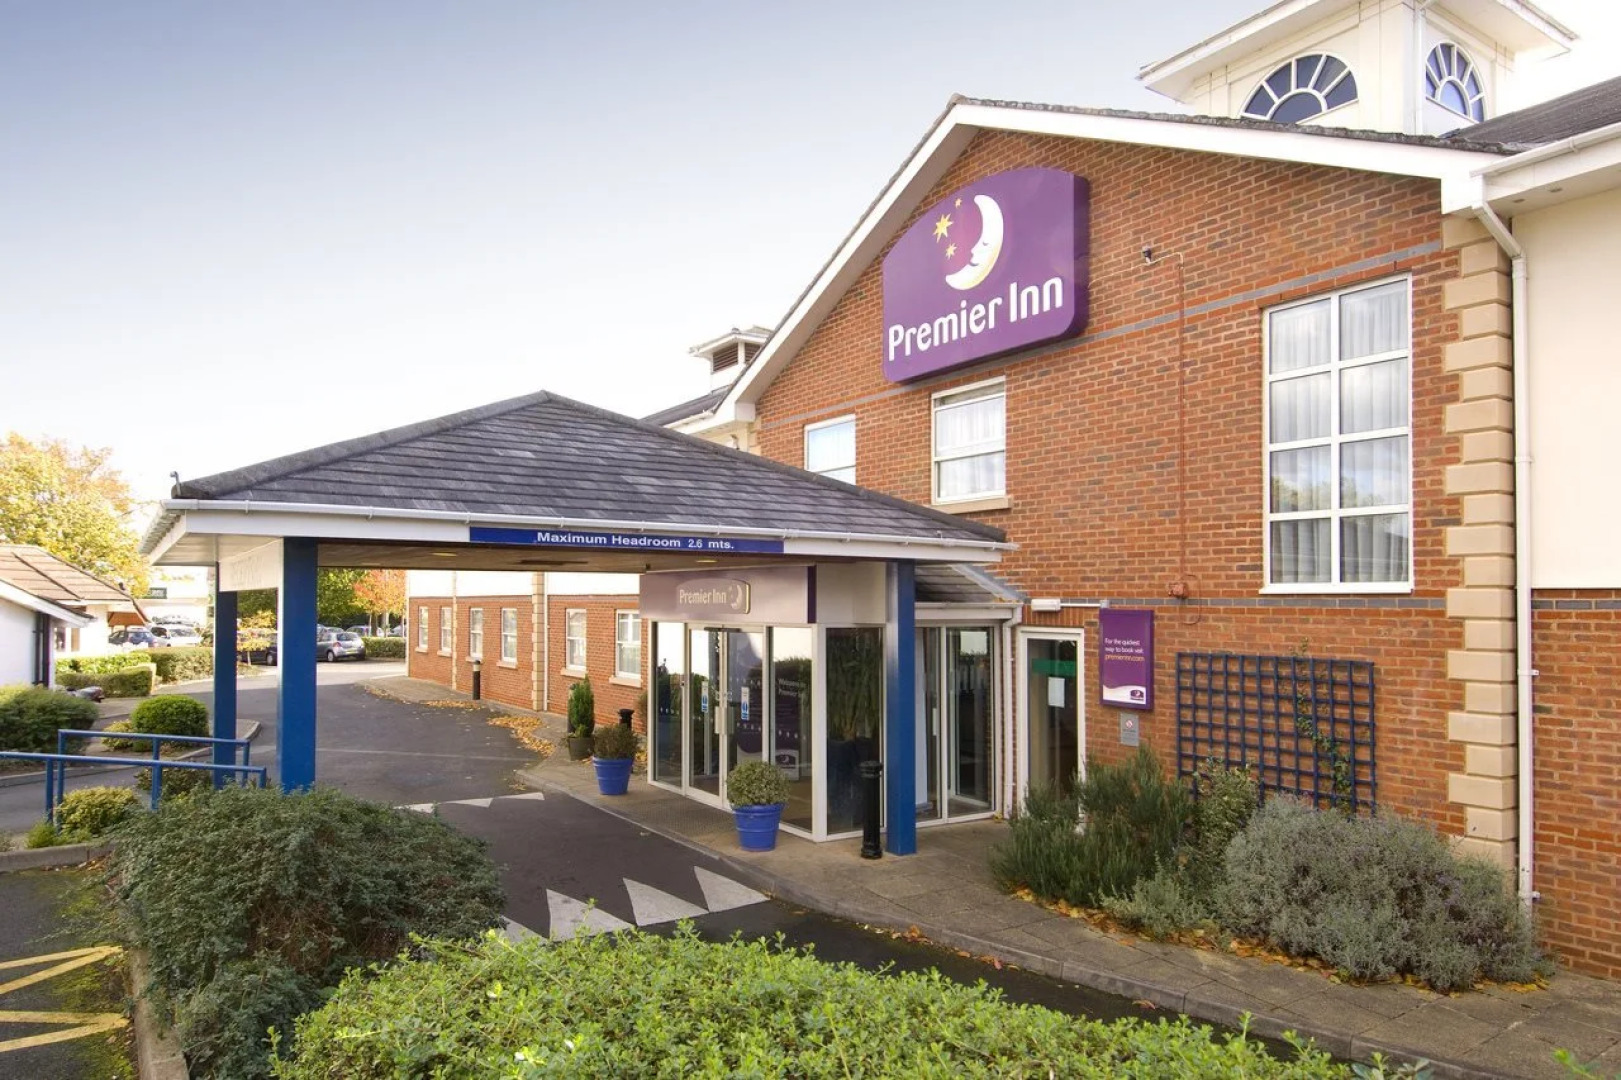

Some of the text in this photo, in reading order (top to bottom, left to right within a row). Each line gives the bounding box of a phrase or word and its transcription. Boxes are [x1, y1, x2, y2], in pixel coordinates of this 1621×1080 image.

[888, 277, 1063, 362] Premier Inn
[537, 532, 734, 549] Maximum Headroom 2.6 mts.
[679, 588, 727, 604] Premier Inn
